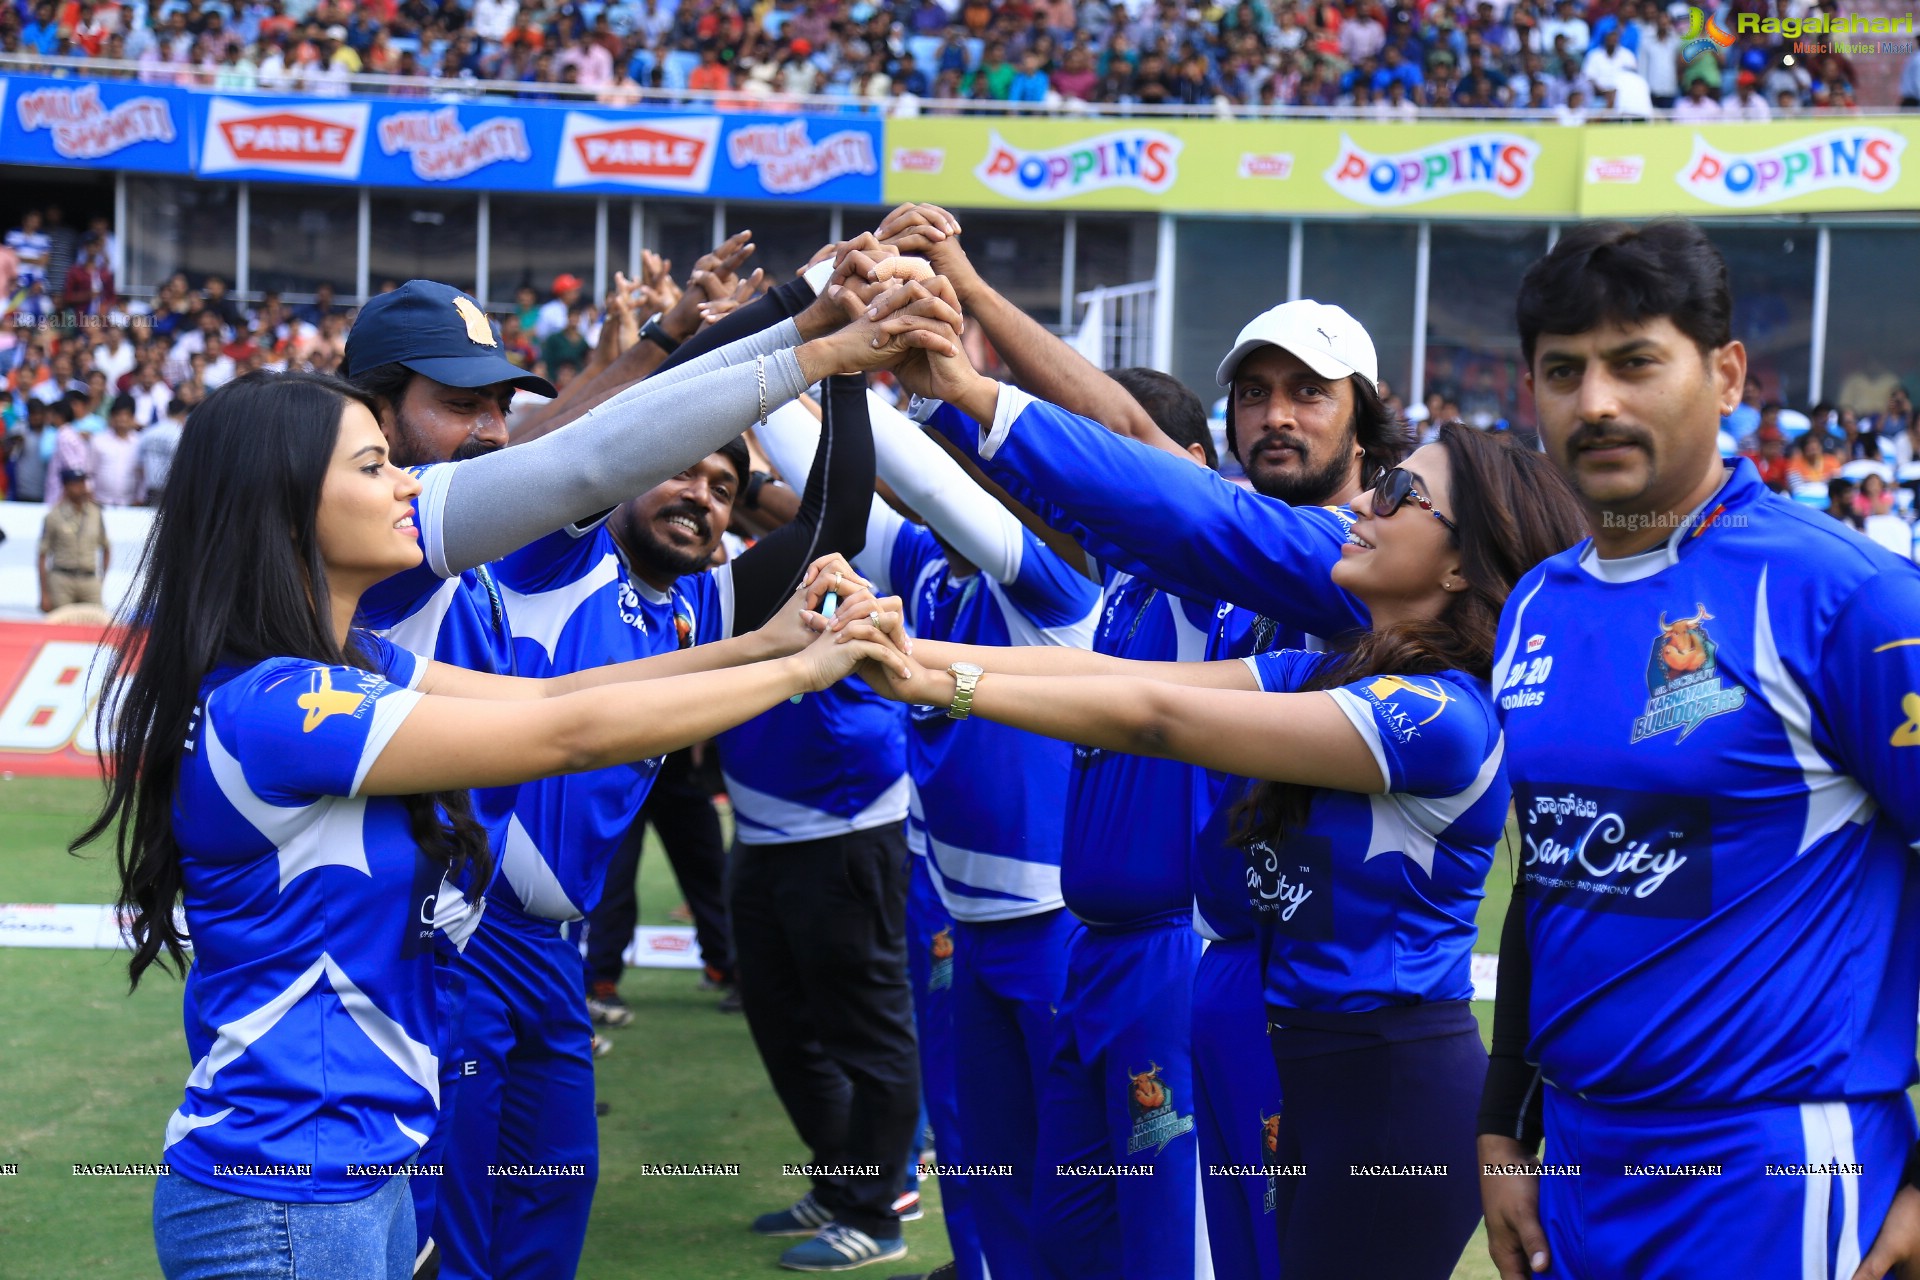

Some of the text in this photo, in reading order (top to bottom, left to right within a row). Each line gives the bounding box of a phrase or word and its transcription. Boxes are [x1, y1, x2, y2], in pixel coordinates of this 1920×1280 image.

[20, 86, 100, 130] MILK
[56, 99, 173, 155] SHAKTI
[380, 107, 459, 152] MILK
[230, 125, 345, 152] PARLE
[415, 120, 529, 177] SHAKTI
[584, 139, 693, 165] PARLE
[731, 122, 808, 166] MILK
[762, 133, 875, 191] SHAKTI
[987, 139, 1171, 189] POPPINS
[1337, 142, 1529, 193] POPPINS
[1691, 137, 1892, 193] POPPINS
[1359, 685, 1408, 744] ENTERTAINMENT
[1633, 687, 1747, 740] BULLDOZERS
[1649, 678, 1721, 714] KARNATAKA
[1382, 701, 1422, 743] AKK
[1577, 812, 1688, 899] City
